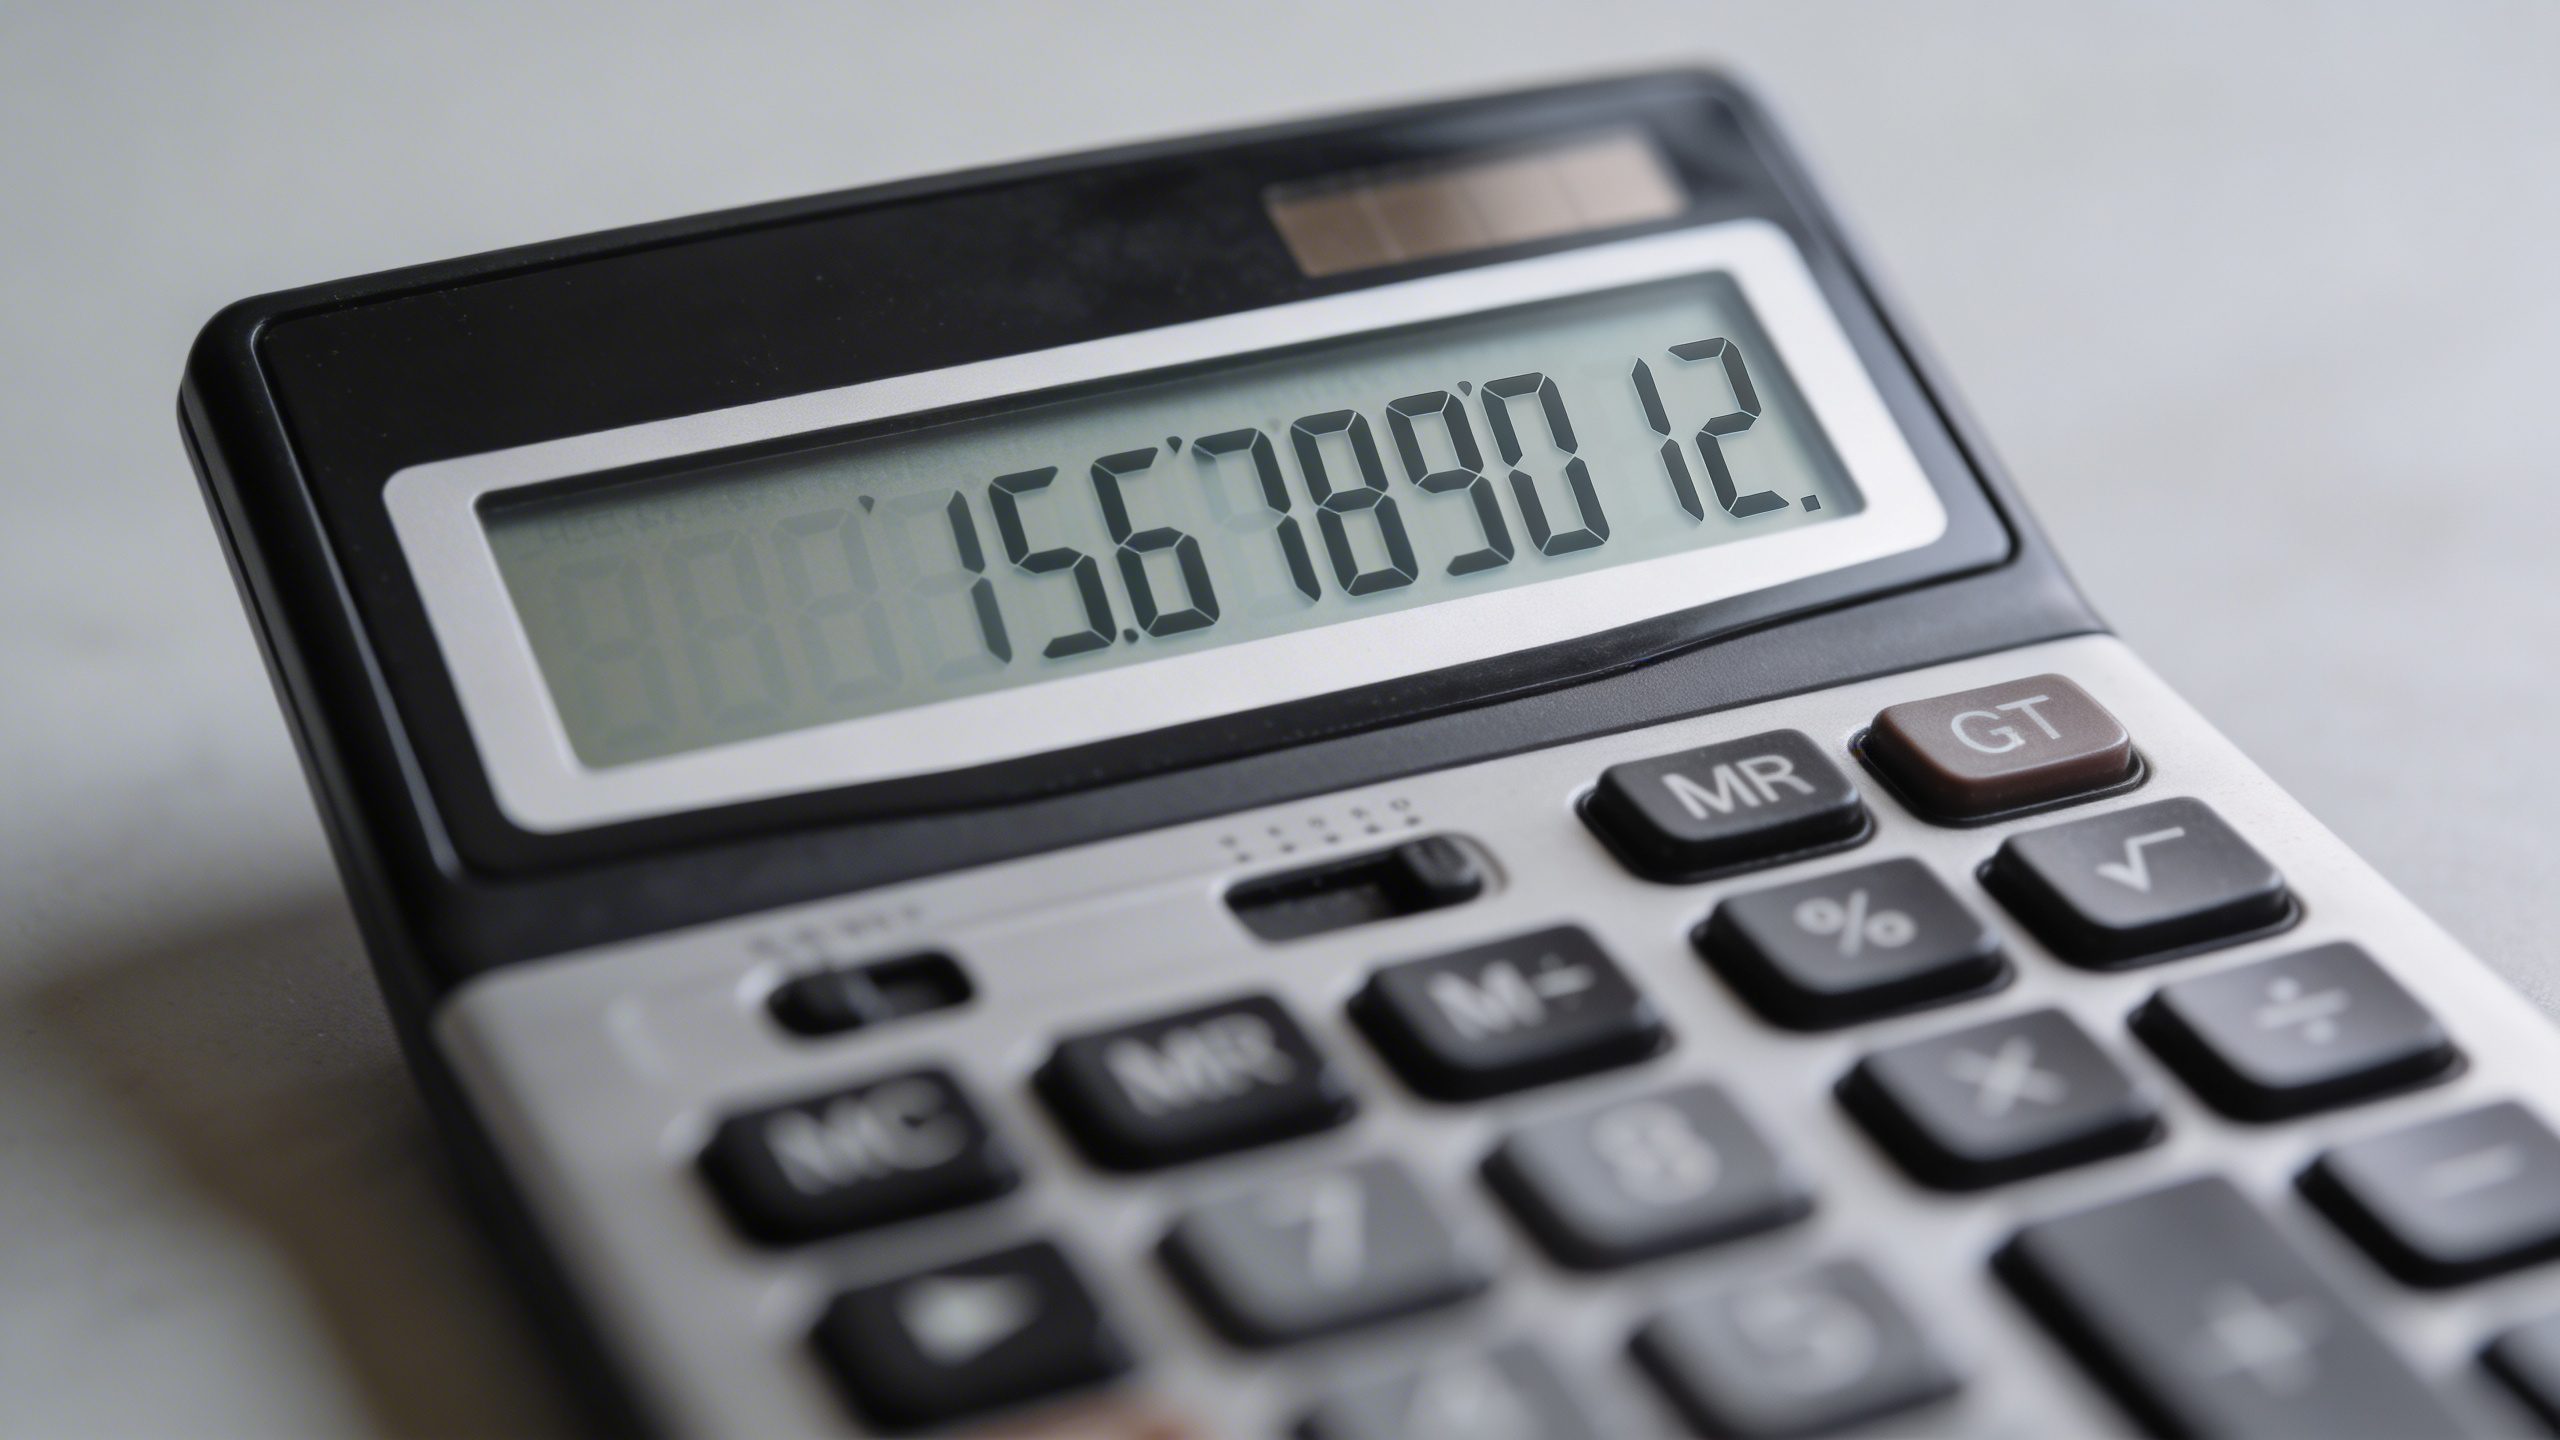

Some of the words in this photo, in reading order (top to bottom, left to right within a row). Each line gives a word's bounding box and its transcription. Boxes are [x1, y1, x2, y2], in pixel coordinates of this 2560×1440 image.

[1949, 693, 2065, 756] GT
[1661, 752, 1815, 821] MR
[1794, 888, 1917, 959] %
[1106, 1010, 1295, 1117] MR
[763, 1077, 969, 1196] MC
